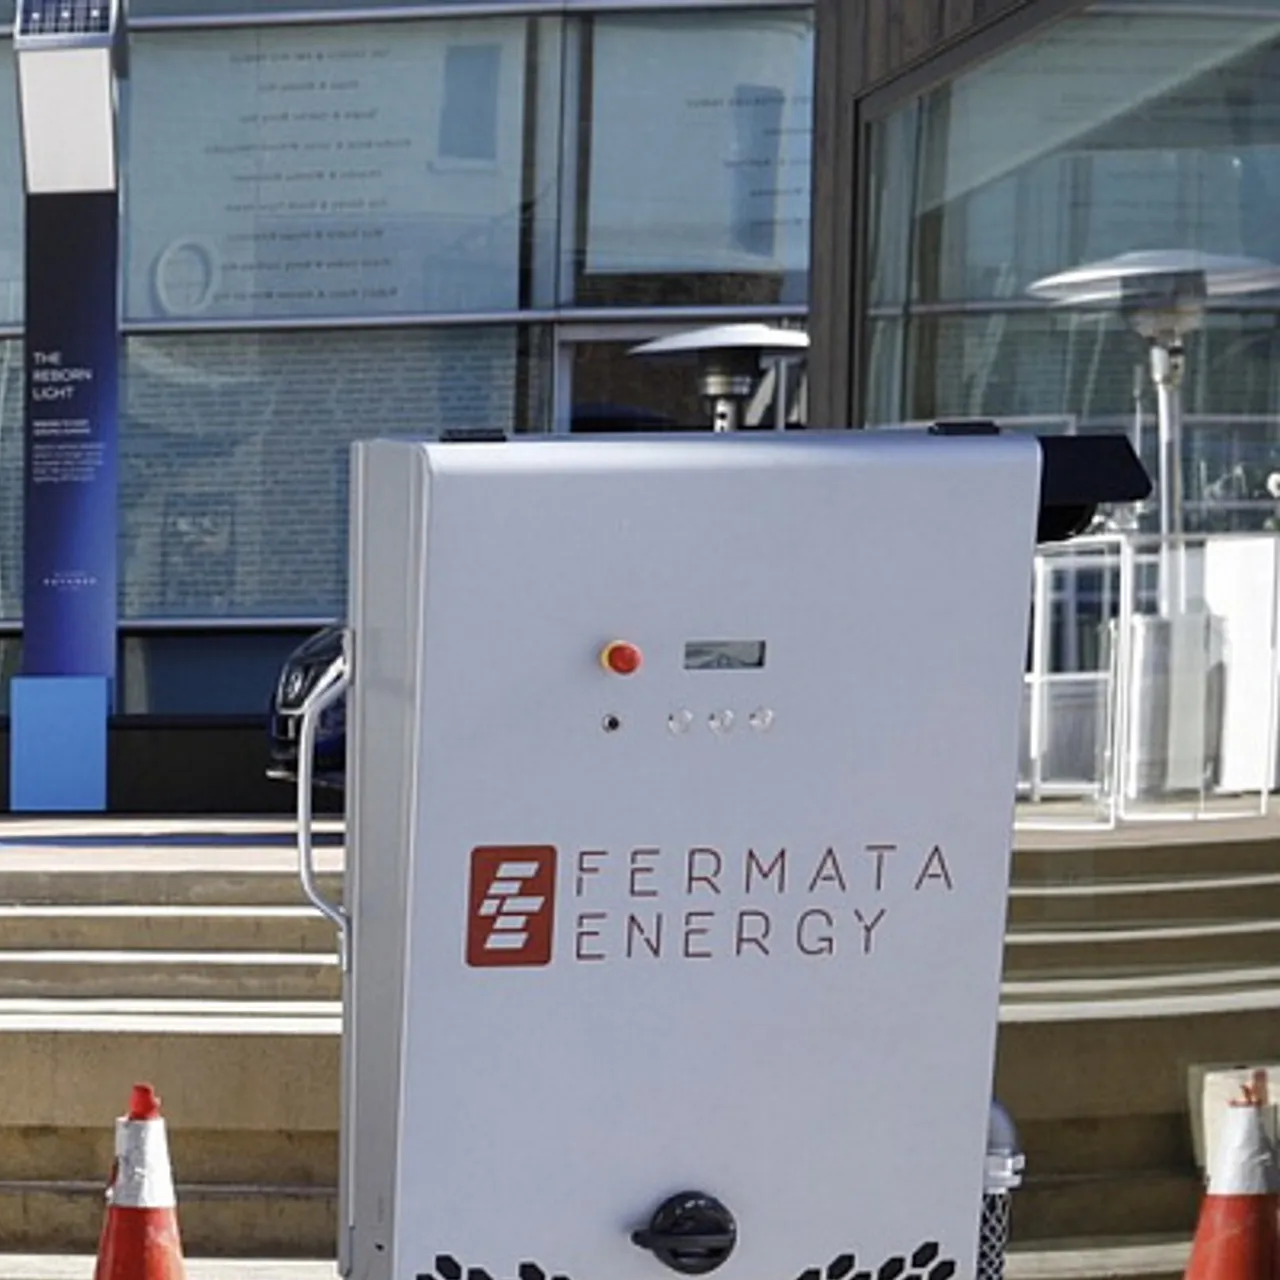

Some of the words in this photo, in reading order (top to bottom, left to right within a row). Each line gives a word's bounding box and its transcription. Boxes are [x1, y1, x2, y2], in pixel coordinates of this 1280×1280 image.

[33, 352, 62, 366] THE
[575, 844, 954, 897] FERMATA
[575, 908, 887, 961] ENERGY
